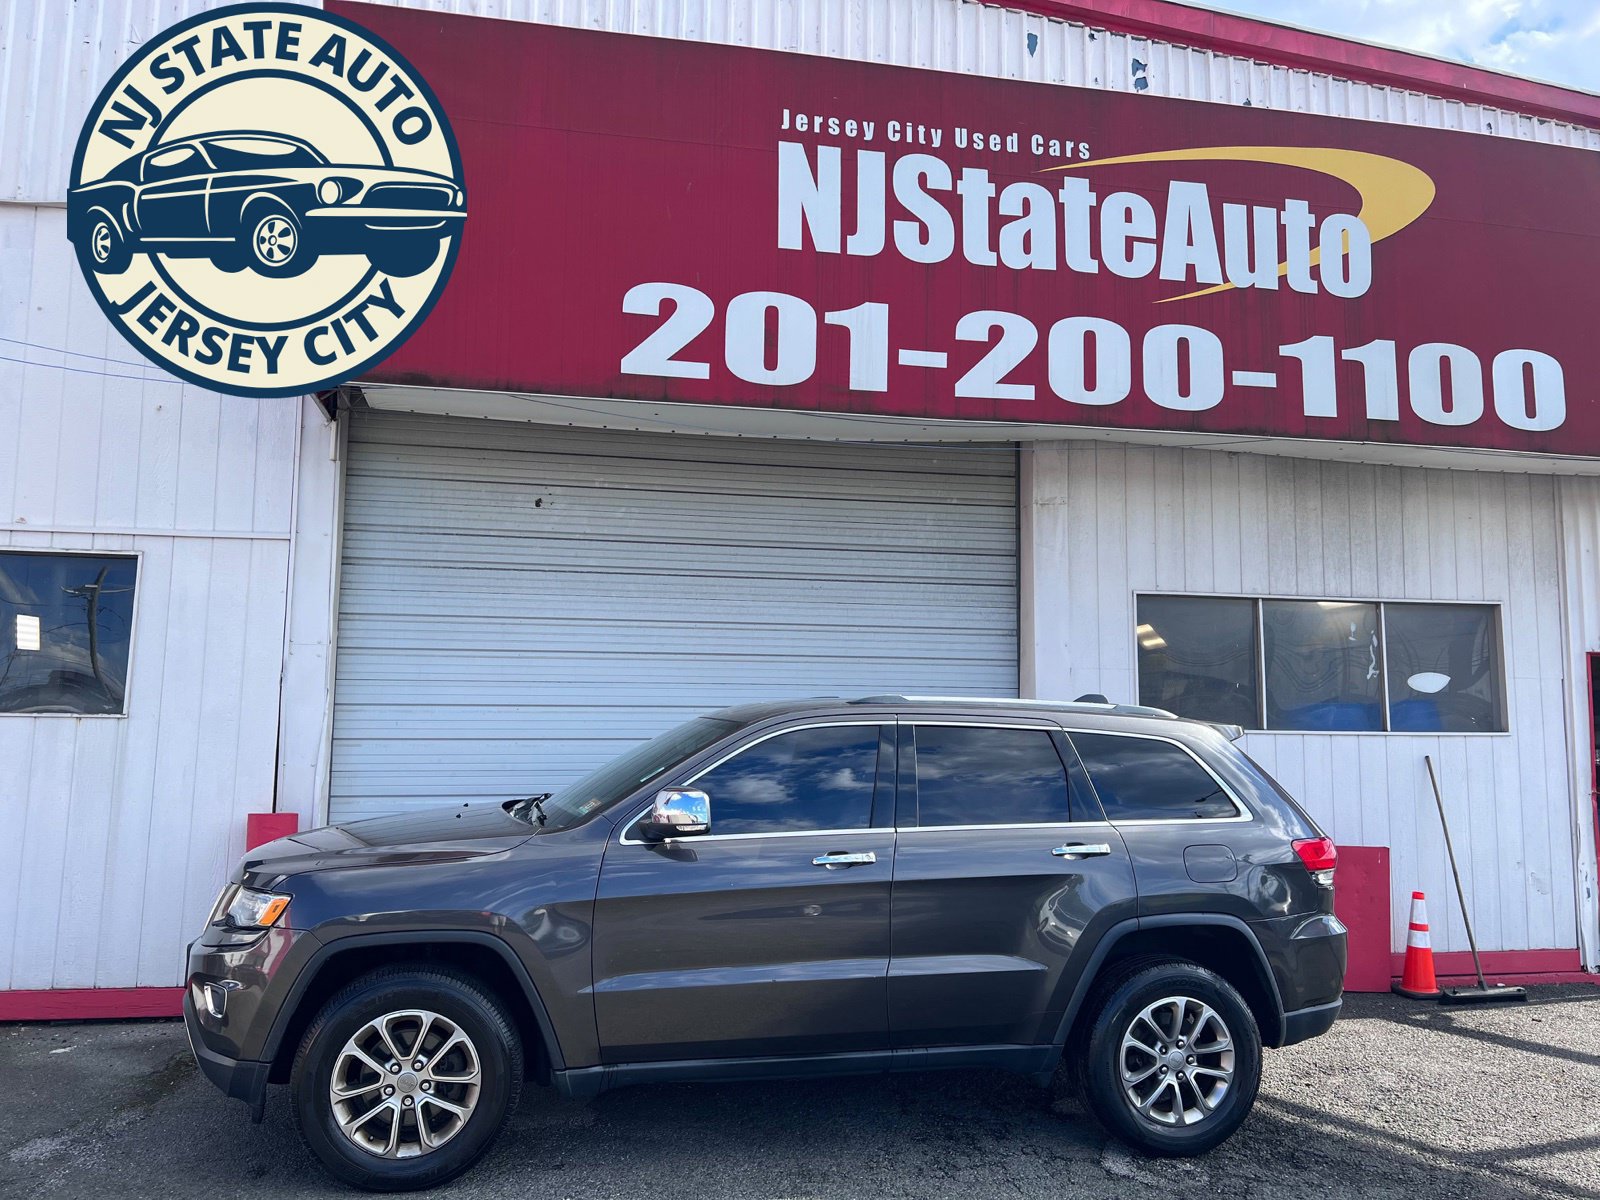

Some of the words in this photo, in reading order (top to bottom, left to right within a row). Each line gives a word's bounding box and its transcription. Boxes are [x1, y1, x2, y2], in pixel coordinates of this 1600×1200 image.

[781, 108, 875, 141] Jersey
[887, 120, 943, 148] City
[954, 127, 1019, 153] Used
[1031, 134, 1091, 159] Cars
[778, 140, 1372, 299] NJStateAuto
[620, 282, 1567, 432] 201-200-1100
